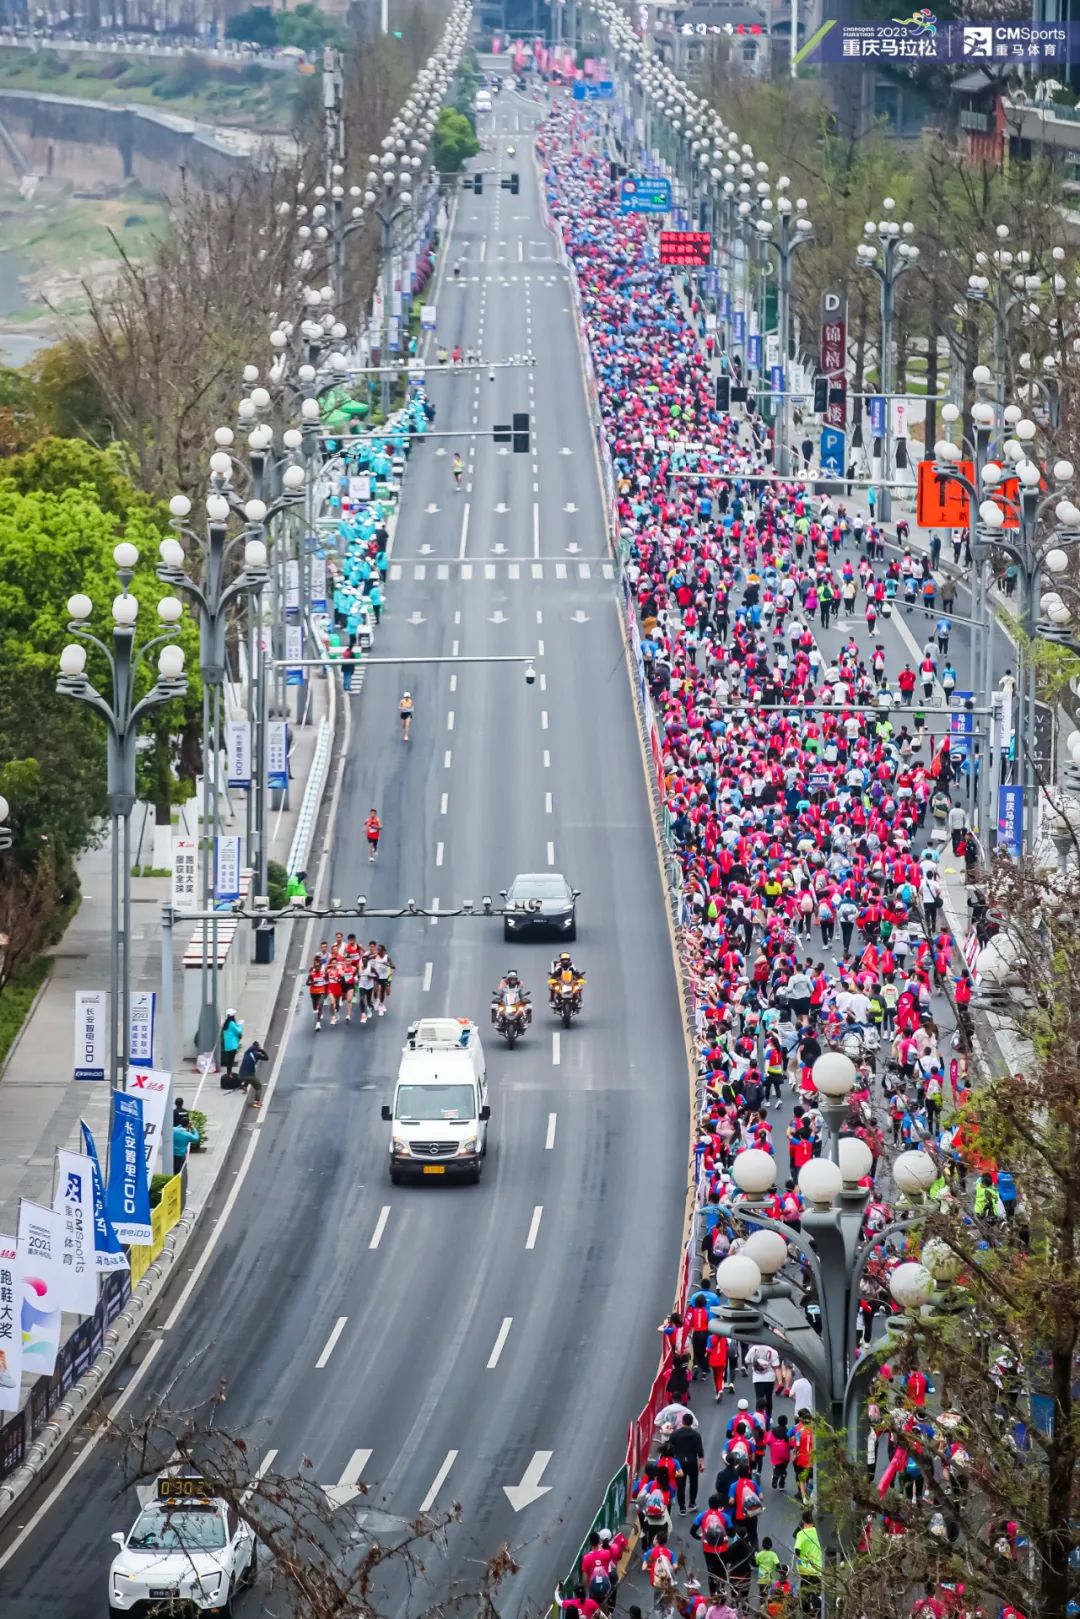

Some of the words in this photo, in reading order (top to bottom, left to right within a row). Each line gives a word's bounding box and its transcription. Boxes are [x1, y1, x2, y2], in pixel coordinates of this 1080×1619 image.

[825, 294, 840, 311] D
[827, 435, 838, 449] P
[1004, 792, 1017, 838] 重庆马拉松
[124, 1121, 137, 1214] 长安智电iDD
[62, 1206, 74, 1266] 重马体育
[75, 1208, 85, 1273] CMSports
[0, 1269, 12, 1339] 跑鞋大奖
